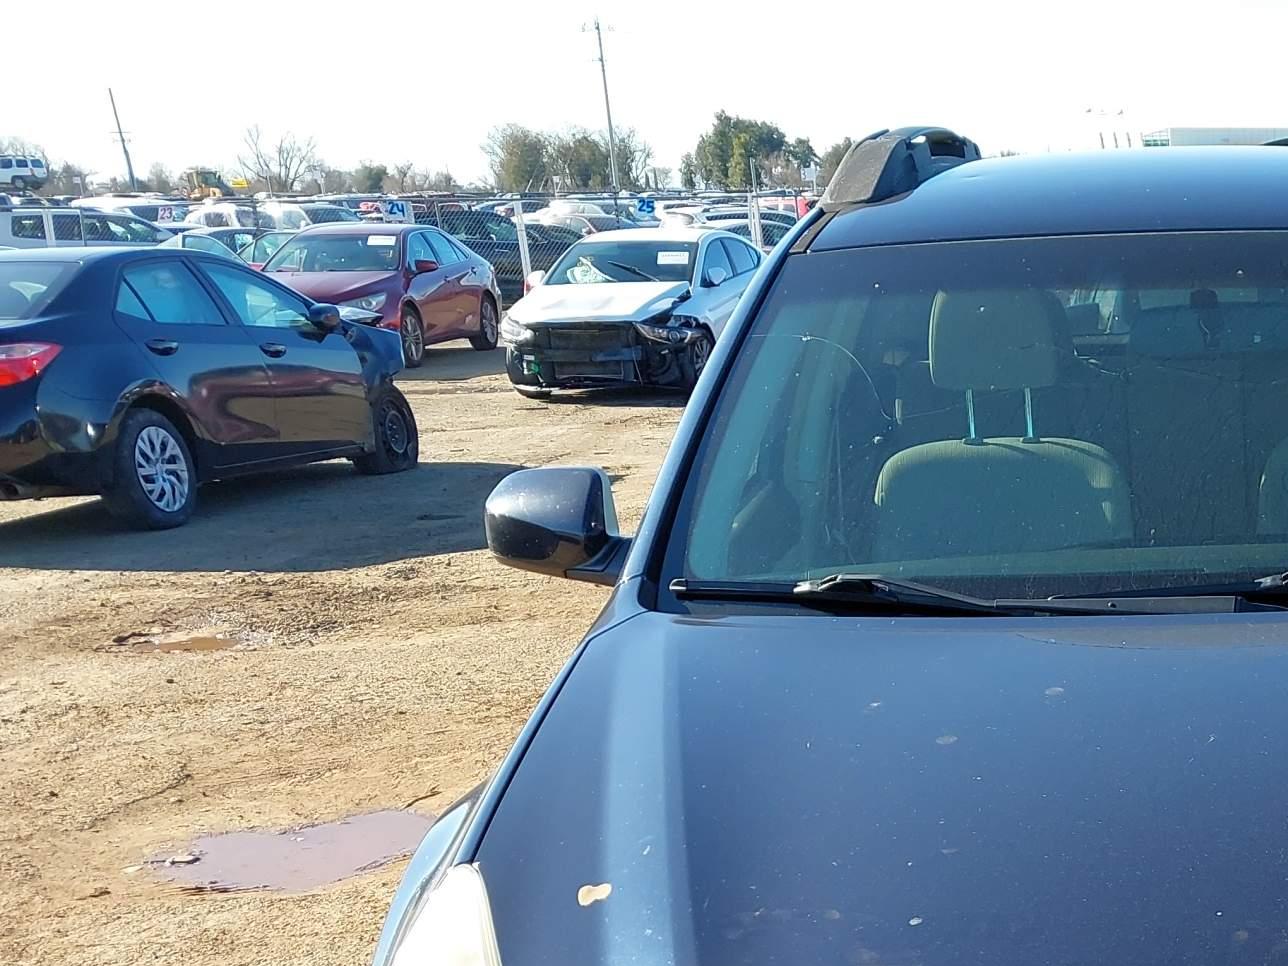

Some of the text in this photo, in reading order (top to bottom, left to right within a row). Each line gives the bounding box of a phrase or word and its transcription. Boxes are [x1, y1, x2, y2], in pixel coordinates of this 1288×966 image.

[160, 206, 173, 220] 23
[388, 201, 406, 218] 24
[638, 198, 655, 213] 25
